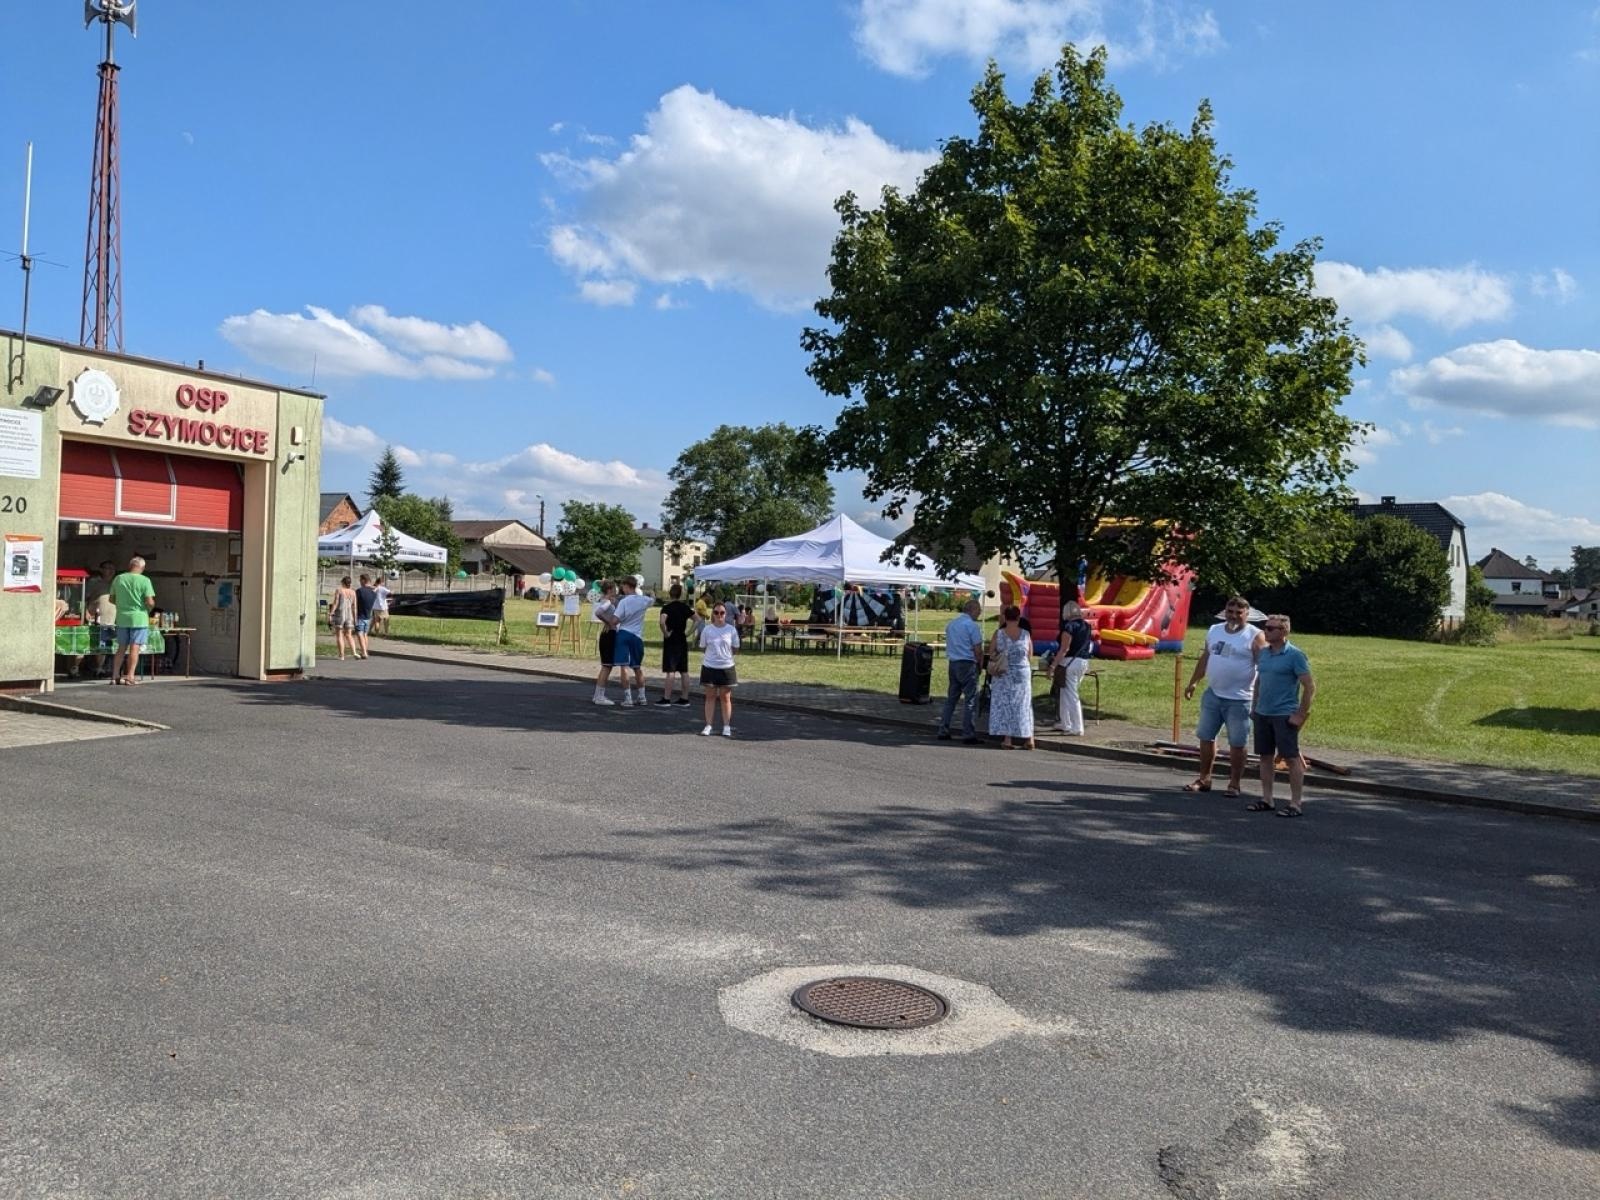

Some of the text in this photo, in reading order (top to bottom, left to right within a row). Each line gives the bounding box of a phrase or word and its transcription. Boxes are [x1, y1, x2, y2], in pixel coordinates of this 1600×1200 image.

[176, 384, 230, 413] OSP
[128, 409, 269, 454] SZYMOCICE
[1, 495, 27, 514] 20
